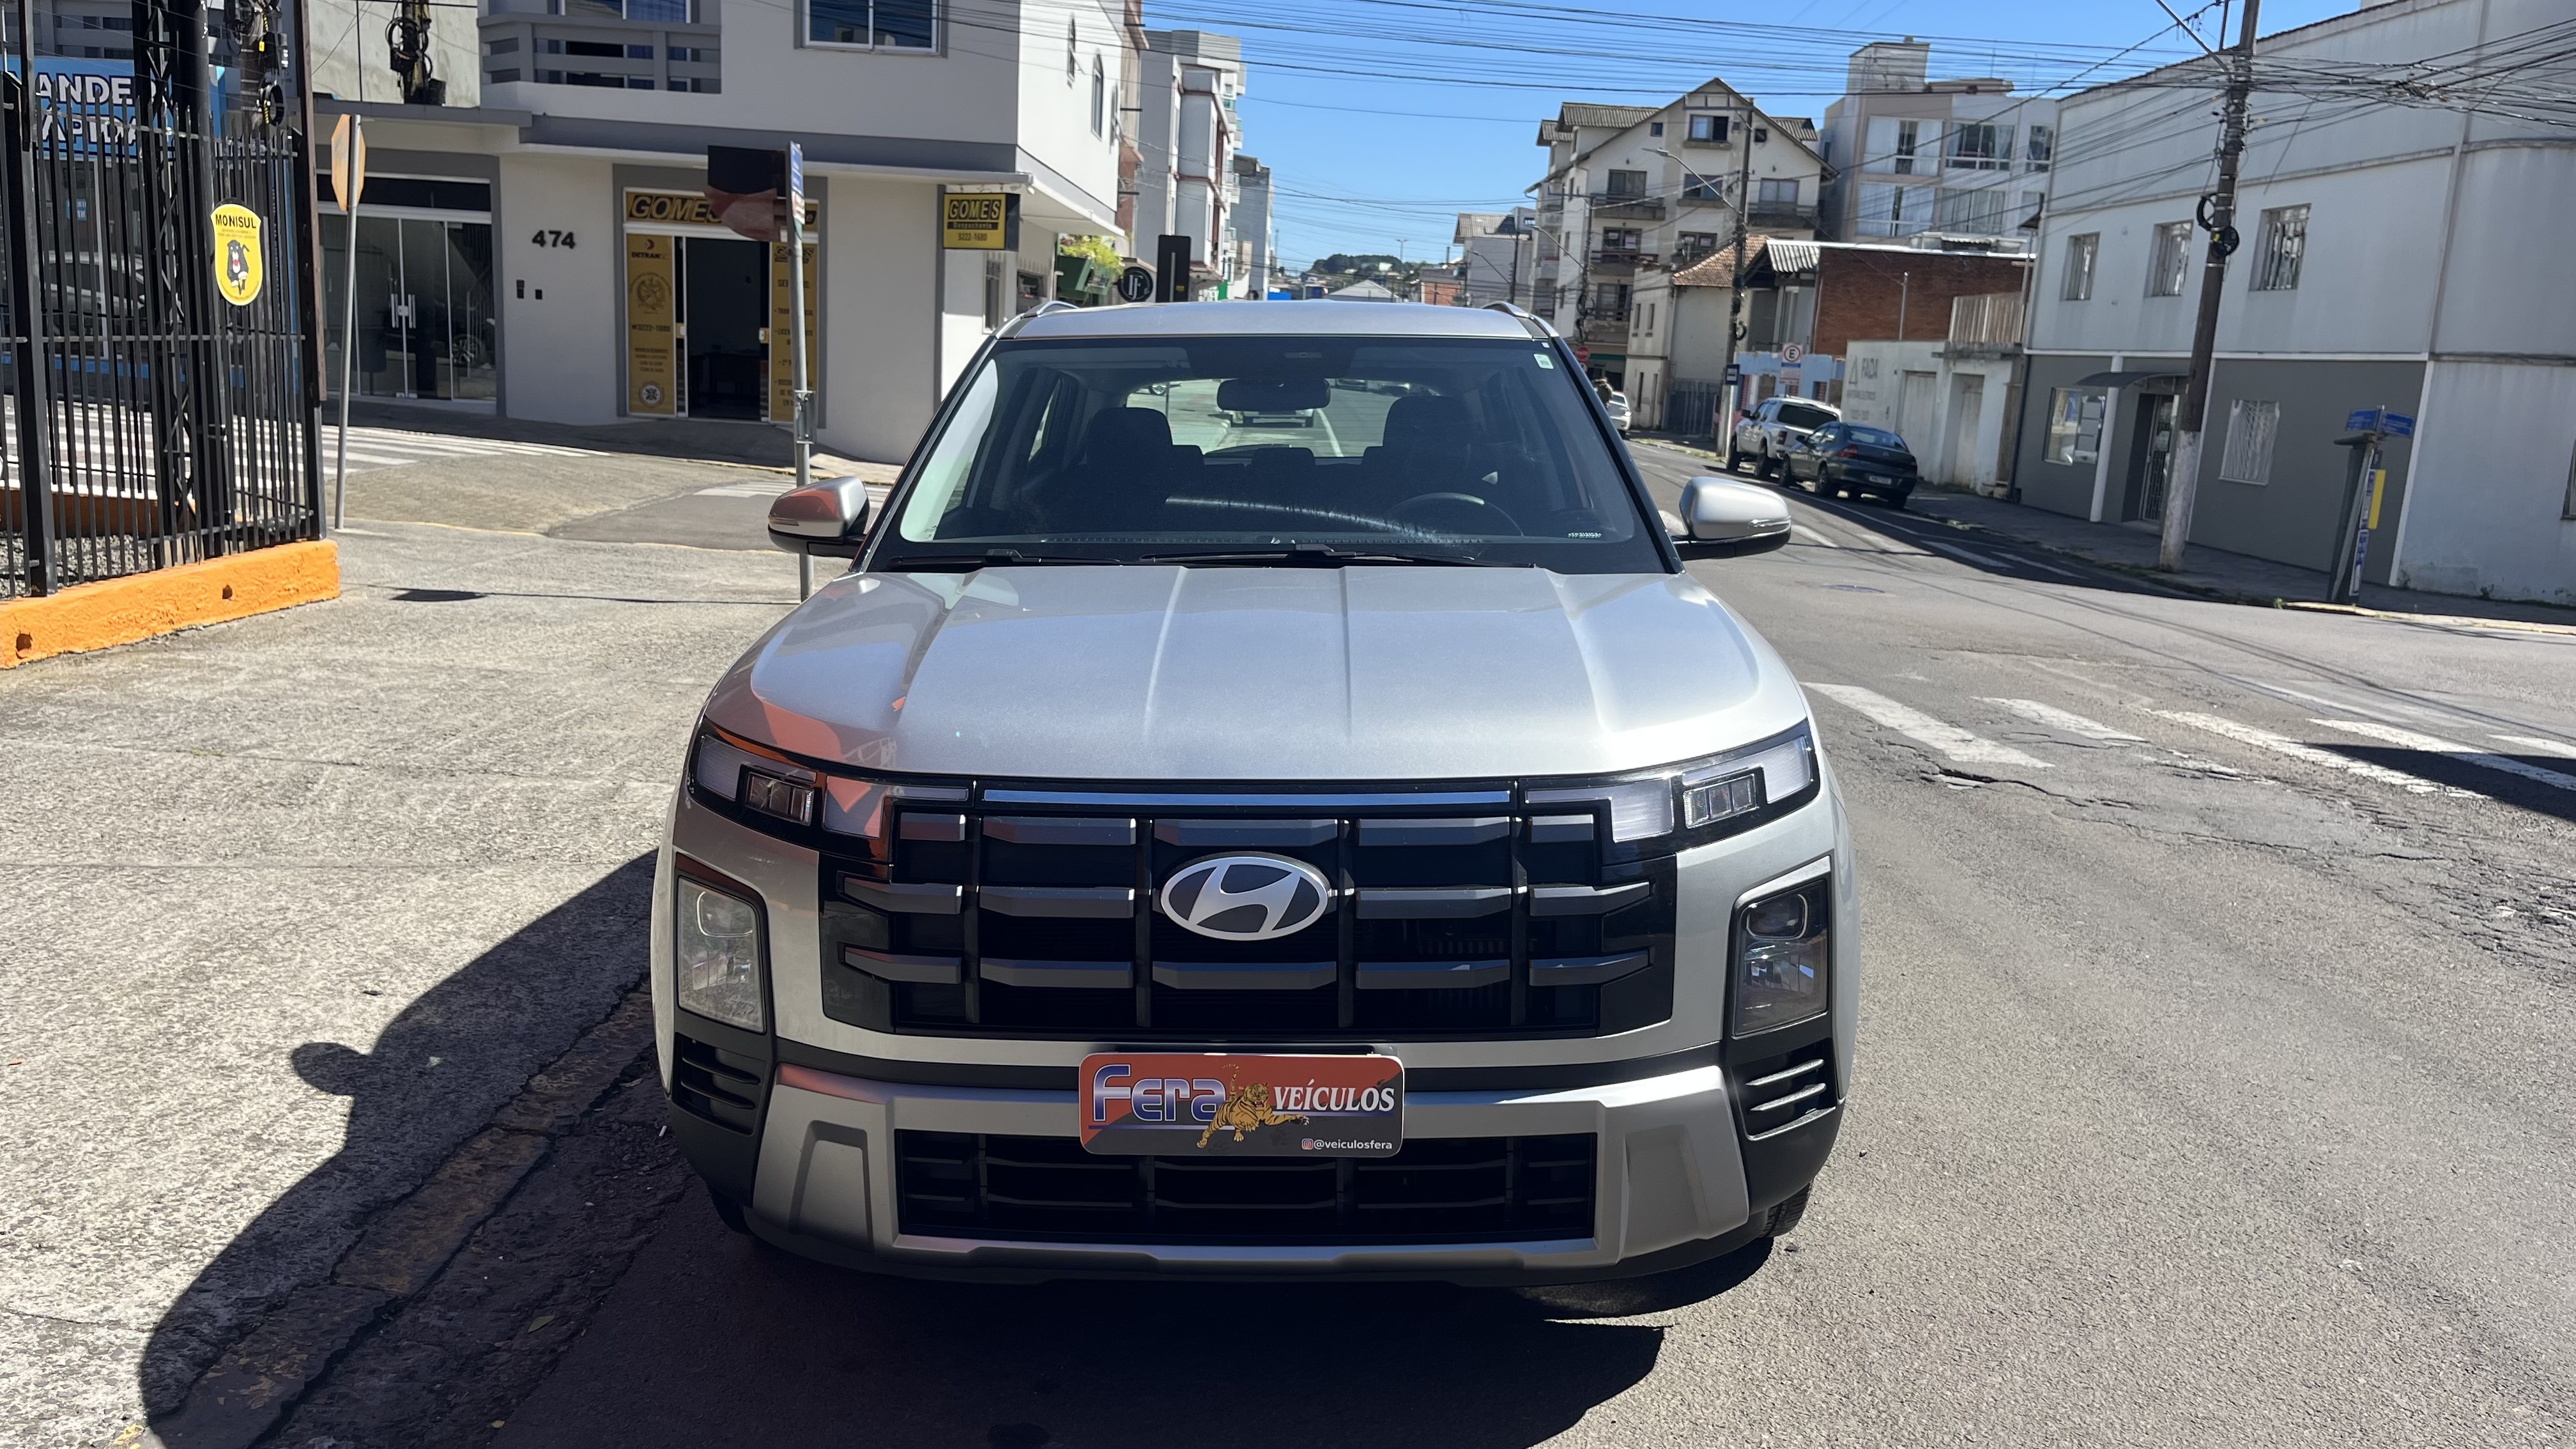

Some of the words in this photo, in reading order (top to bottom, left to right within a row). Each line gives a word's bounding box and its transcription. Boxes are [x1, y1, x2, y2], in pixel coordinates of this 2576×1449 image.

[949, 200, 1000, 218] GOMES
[215, 214, 257, 229] MONISUL
[532, 230, 576, 249] 474
[1788, 348, 1796, 358] E
[1273, 1078, 1395, 1112] VEÍCULOS
[1313, 1138, 1393, 1151] @veiculosfera
